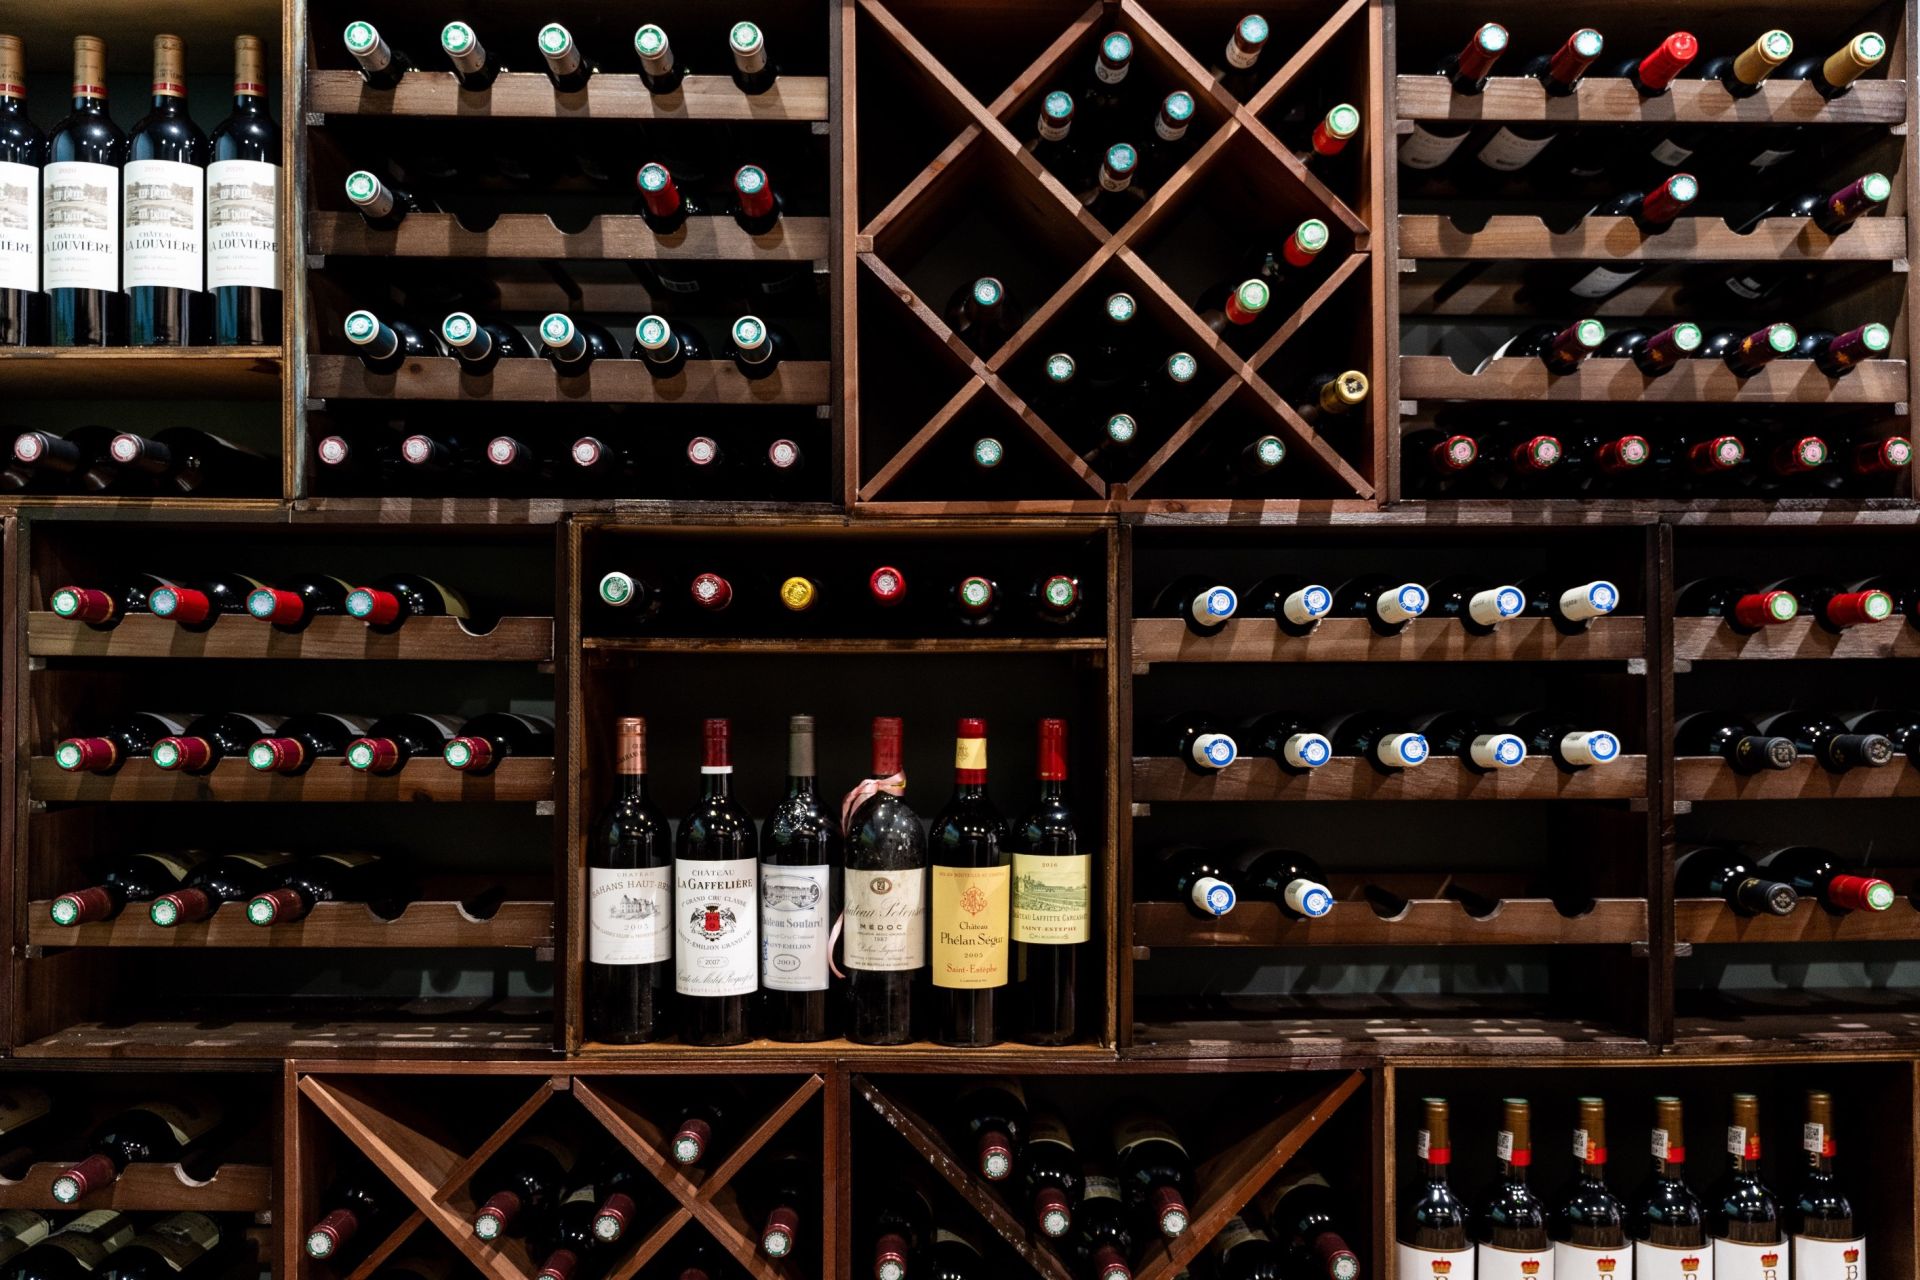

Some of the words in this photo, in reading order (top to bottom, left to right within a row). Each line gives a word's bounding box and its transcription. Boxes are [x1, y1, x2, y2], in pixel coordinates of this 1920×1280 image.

[136, 237, 199, 254] LOUVIÈRE
[218, 237, 279, 253] LOUVIÈRE
[940, 931, 976, 946] Phélan
[1846, 1264, 1859, 1280] B
